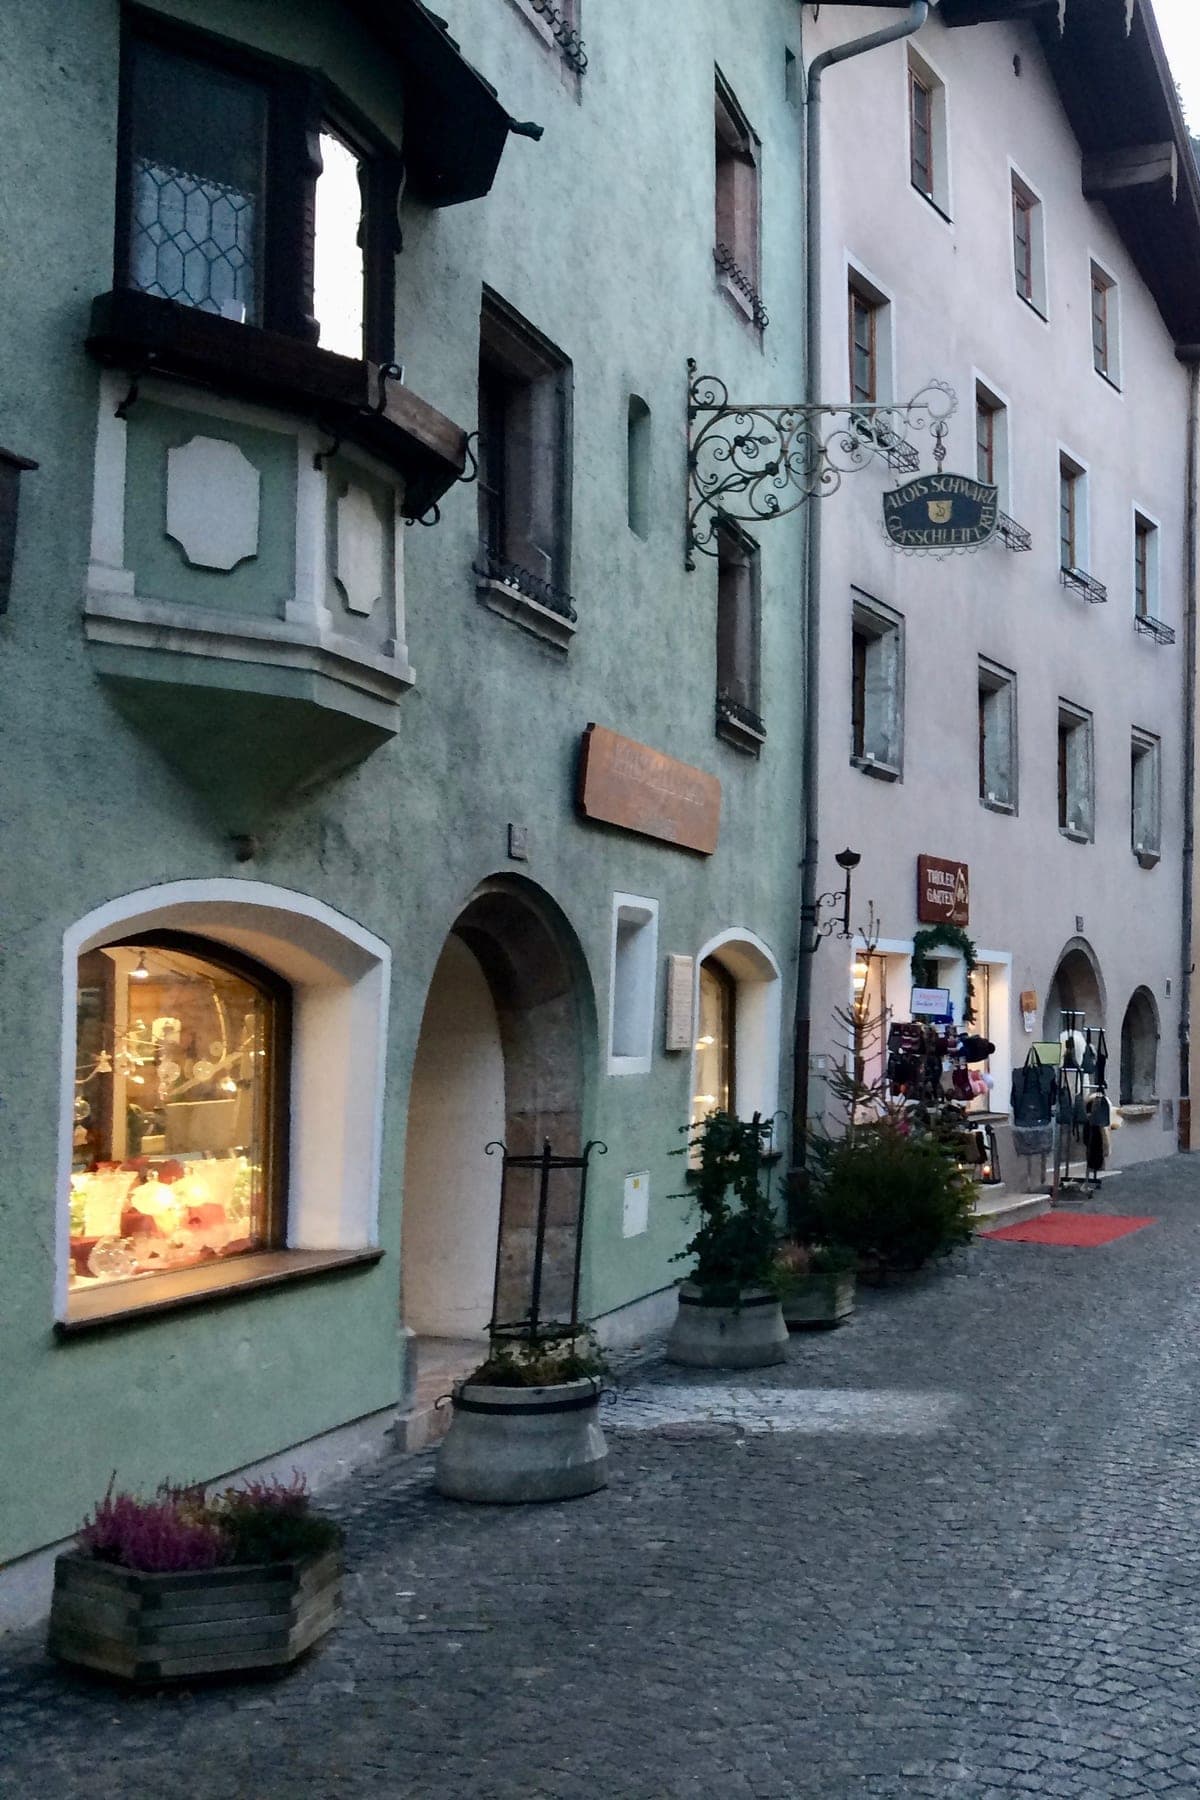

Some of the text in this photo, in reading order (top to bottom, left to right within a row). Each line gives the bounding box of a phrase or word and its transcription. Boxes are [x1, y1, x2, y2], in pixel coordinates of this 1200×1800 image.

[886, 478, 995, 508] ALOIS SCHWARZ
[926, 868, 955, 888] TIROLER
[926, 888, 955, 905] GARTEN
